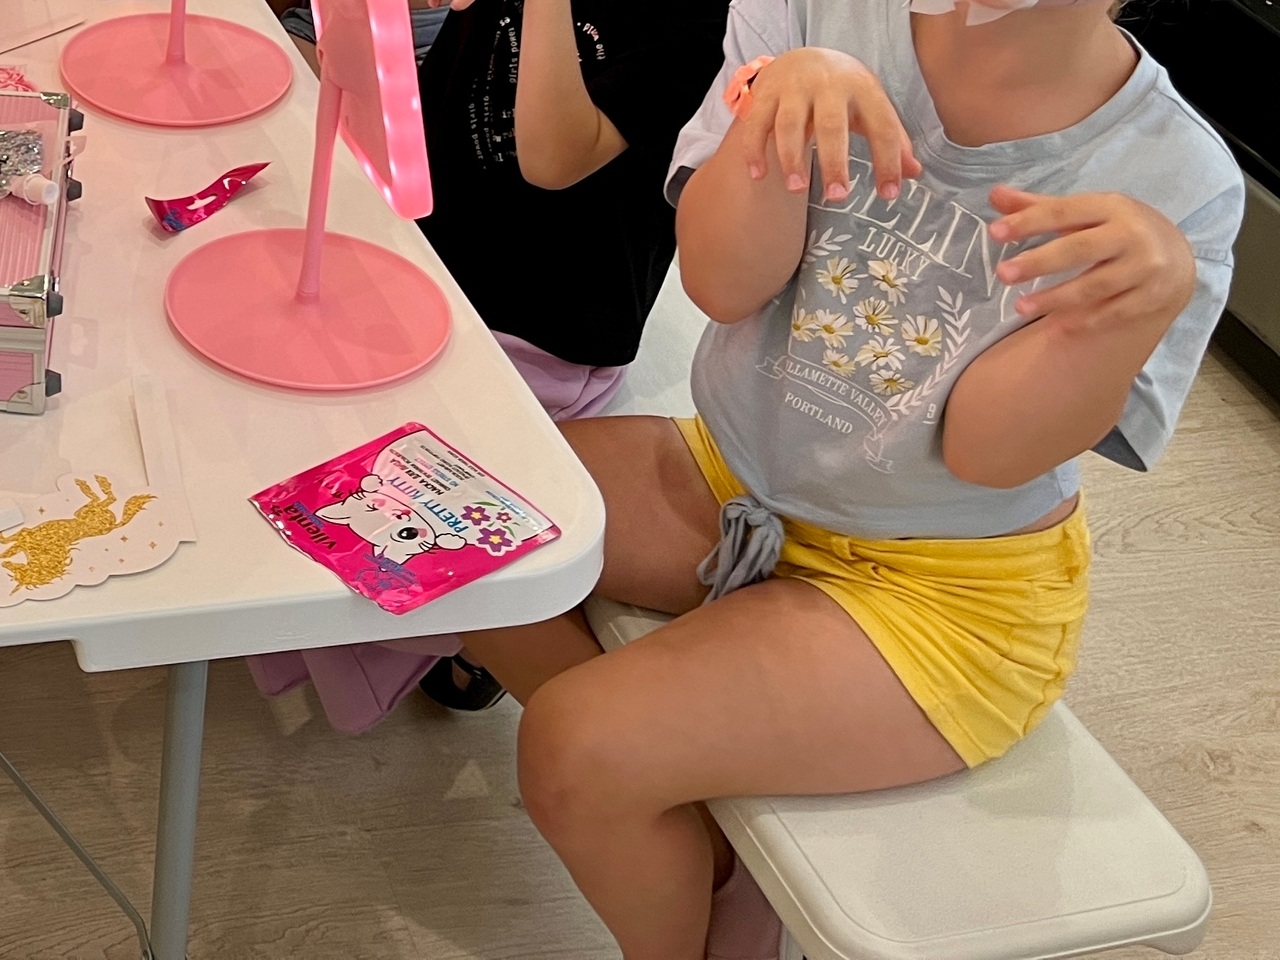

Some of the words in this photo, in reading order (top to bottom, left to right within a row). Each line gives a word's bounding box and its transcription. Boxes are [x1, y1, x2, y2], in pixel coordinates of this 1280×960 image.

[858, 227, 933, 280] LUCKY
[784, 391, 854, 435] PORTLAND
[850, 387, 888, 427] VALLEY
[386, 476, 424, 500] KITTY
[419, 479, 445, 496] МАСКА
[283, 504, 337, 550] vilenta
[418, 498, 469, 534] PRETTY
